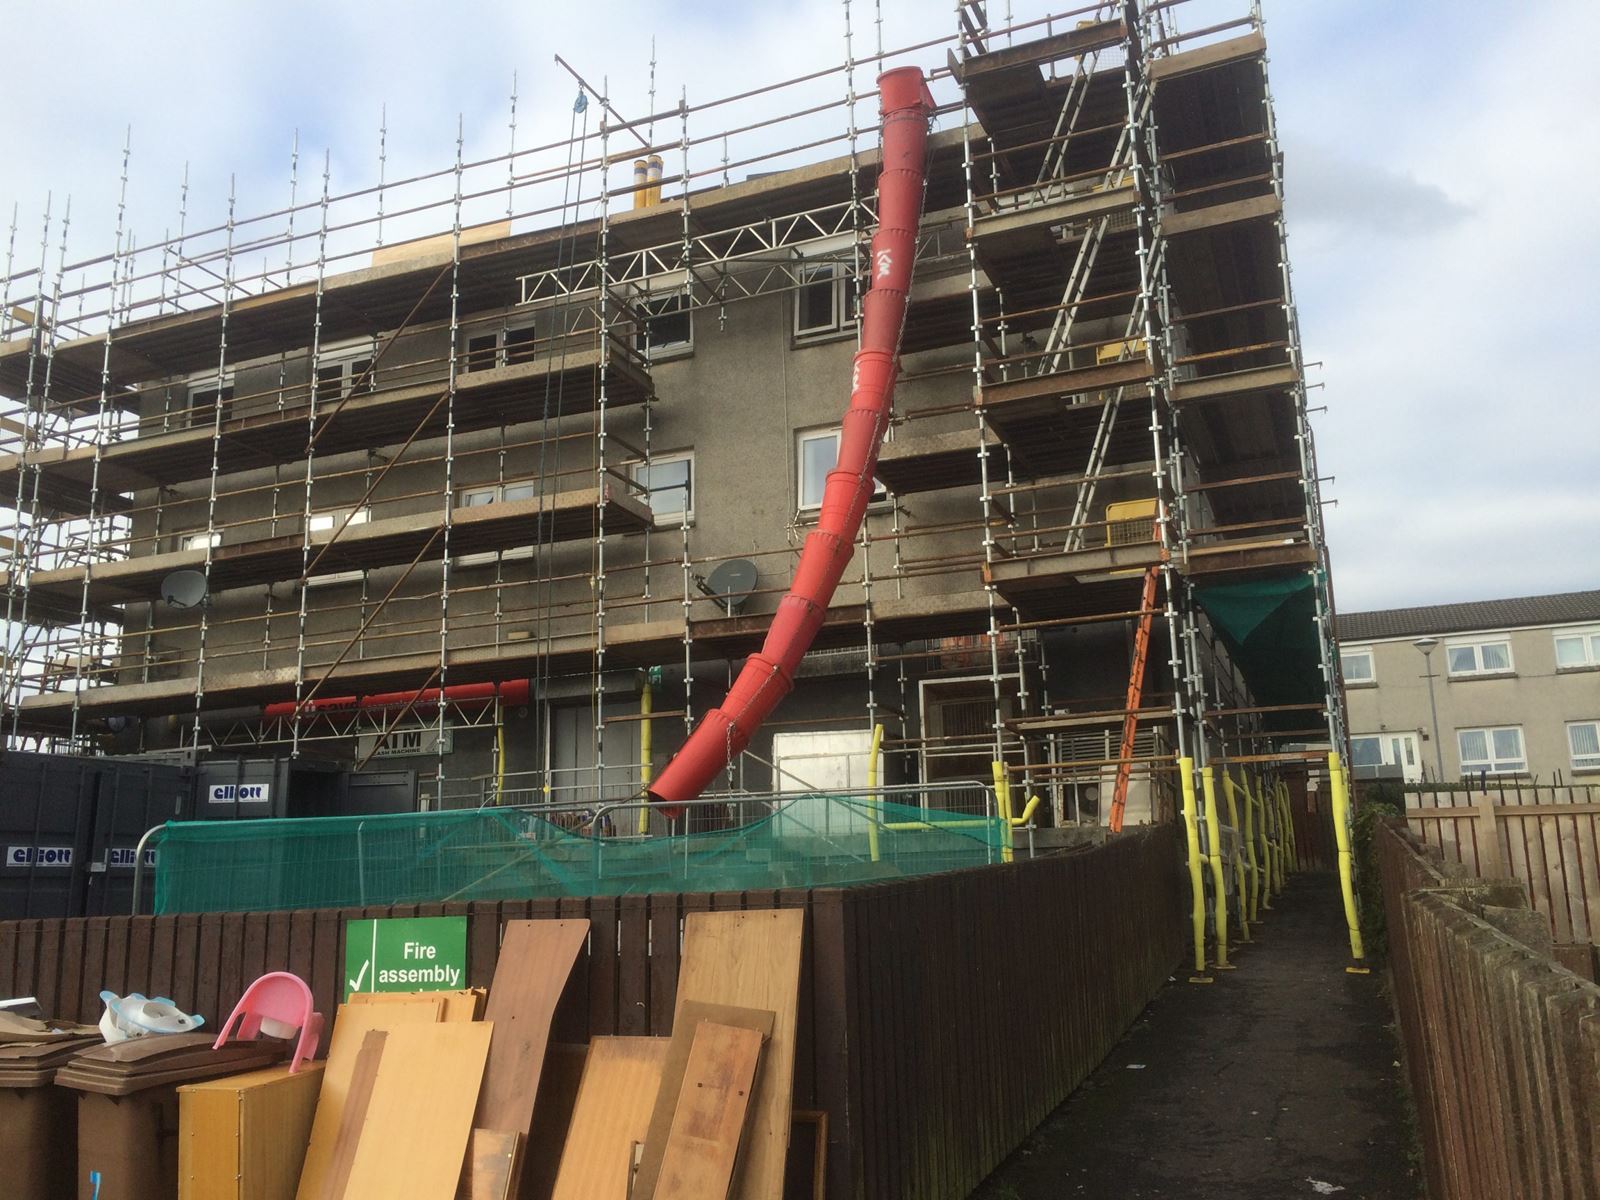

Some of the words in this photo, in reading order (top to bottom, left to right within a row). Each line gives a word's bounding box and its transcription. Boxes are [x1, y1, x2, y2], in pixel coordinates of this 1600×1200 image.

[391, 748, 421, 756] MACHINE
[213, 786, 262, 799] ellott
[111, 849, 156, 864] ellitt
[403, 942, 437, 960] Fire
[378, 964, 460, 986] assembly
